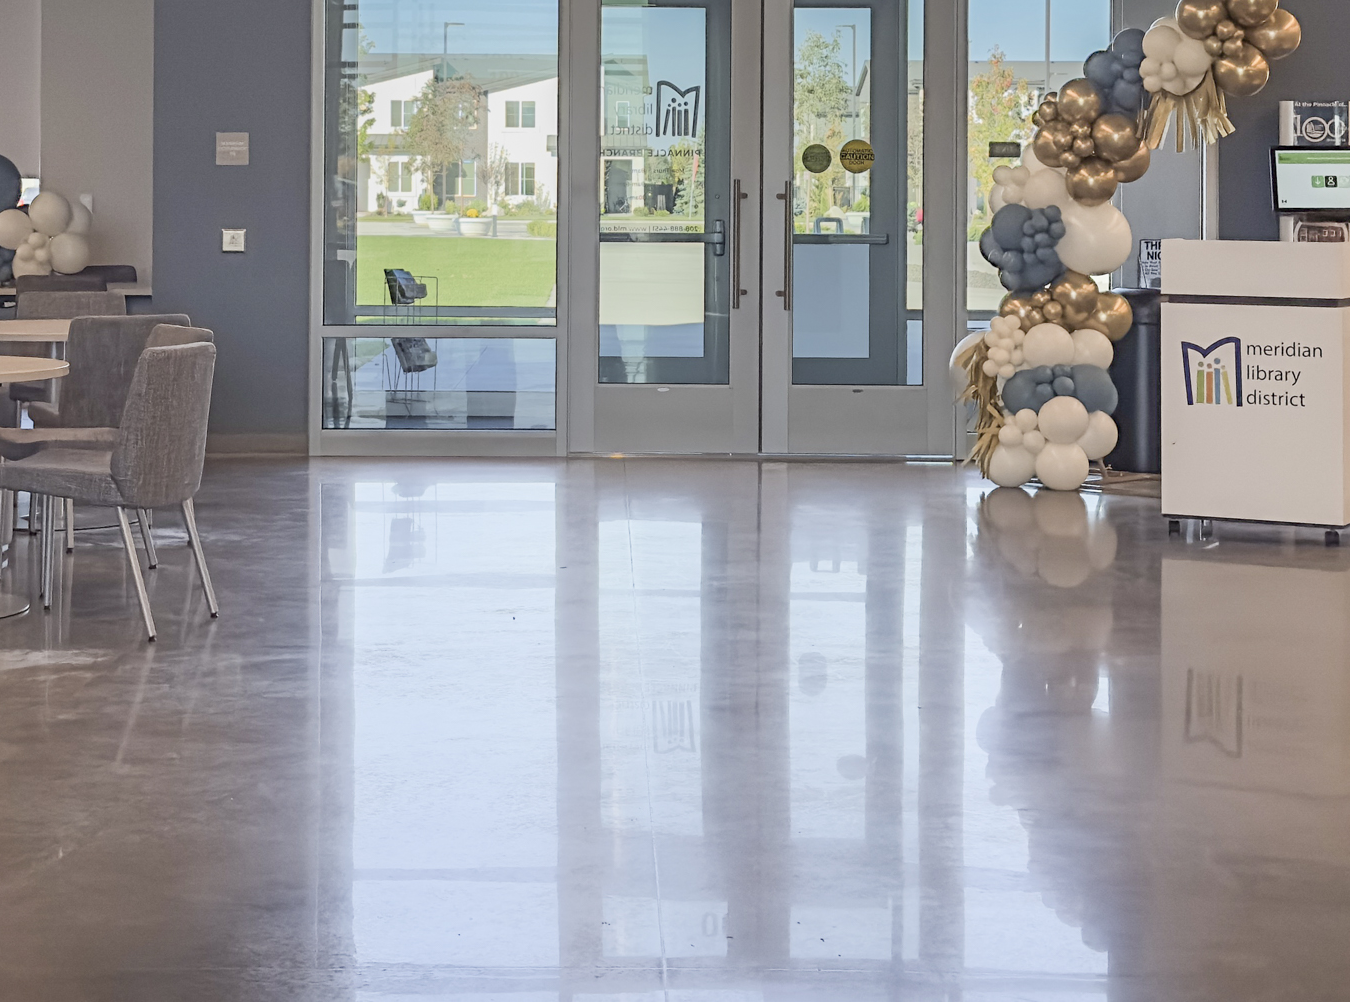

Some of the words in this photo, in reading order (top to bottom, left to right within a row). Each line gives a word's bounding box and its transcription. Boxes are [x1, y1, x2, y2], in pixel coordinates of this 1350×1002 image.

[1246, 342, 1323, 358] meridian
[1246, 364, 1301, 386] library
[1246, 389, 1306, 407] district
